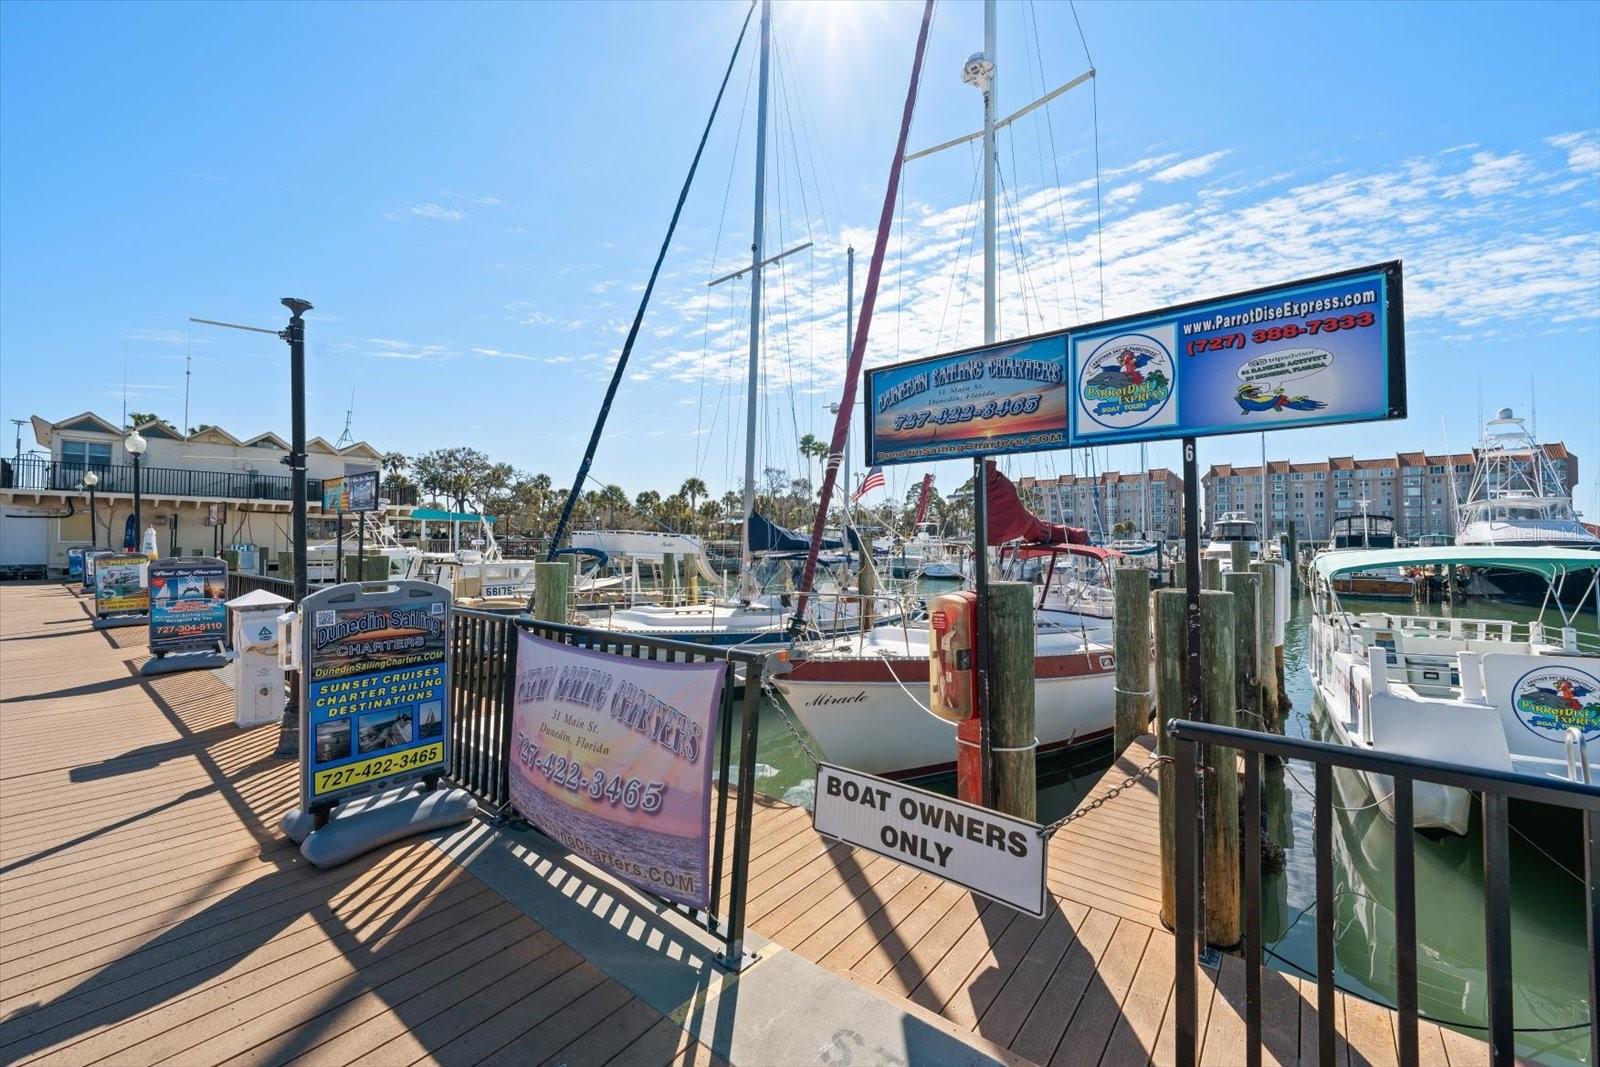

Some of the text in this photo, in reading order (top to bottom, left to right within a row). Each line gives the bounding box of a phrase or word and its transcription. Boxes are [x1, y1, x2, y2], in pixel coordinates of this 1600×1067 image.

[1183, 289, 1377, 335] www.ParrotDiseExpress.com
[1186, 311, 1376, 357] (727) 388-7333
[1250, 362, 1286, 374] RANKED
[1287, 354, 1328, 367] ACTIVITY
[1268, 350, 1315, 363] tripadvisor
[1292, 362, 1328, 373] FLORIDA
[877, 358, 1062, 414] DUNEDIN SAILING CHARTERS
[950, 385, 970, 394] Main
[966, 389, 996, 400] Florida
[893, 394, 1042, 431] 727-422-3465
[1102, 405, 1120, 414] BOAT
[1185, 444, 1194, 462] 6
[975, 463, 981, 478] 7
[157, 622, 222, 634] 727-304-5110
[317, 609, 441, 651] Dunedin Sailing
[336, 636, 425, 656] CHARTERS
[315, 650, 444, 678] DunedinSailingCharters.COM
[316, 677, 442, 707] CHARTER SAILING
[319, 667, 439, 694] SUNSET CRUISES
[328, 690, 433, 717] DESTINATIONS
[551, 709, 599, 734] 51 Main St.
[610, 679, 703, 763] CHARTERS
[575, 734, 610, 756] Florida
[321, 747, 438, 789] 727-422-3465
[826, 775, 1028, 858] BOAT OWNERS
[880, 825, 953, 868] ONLY
